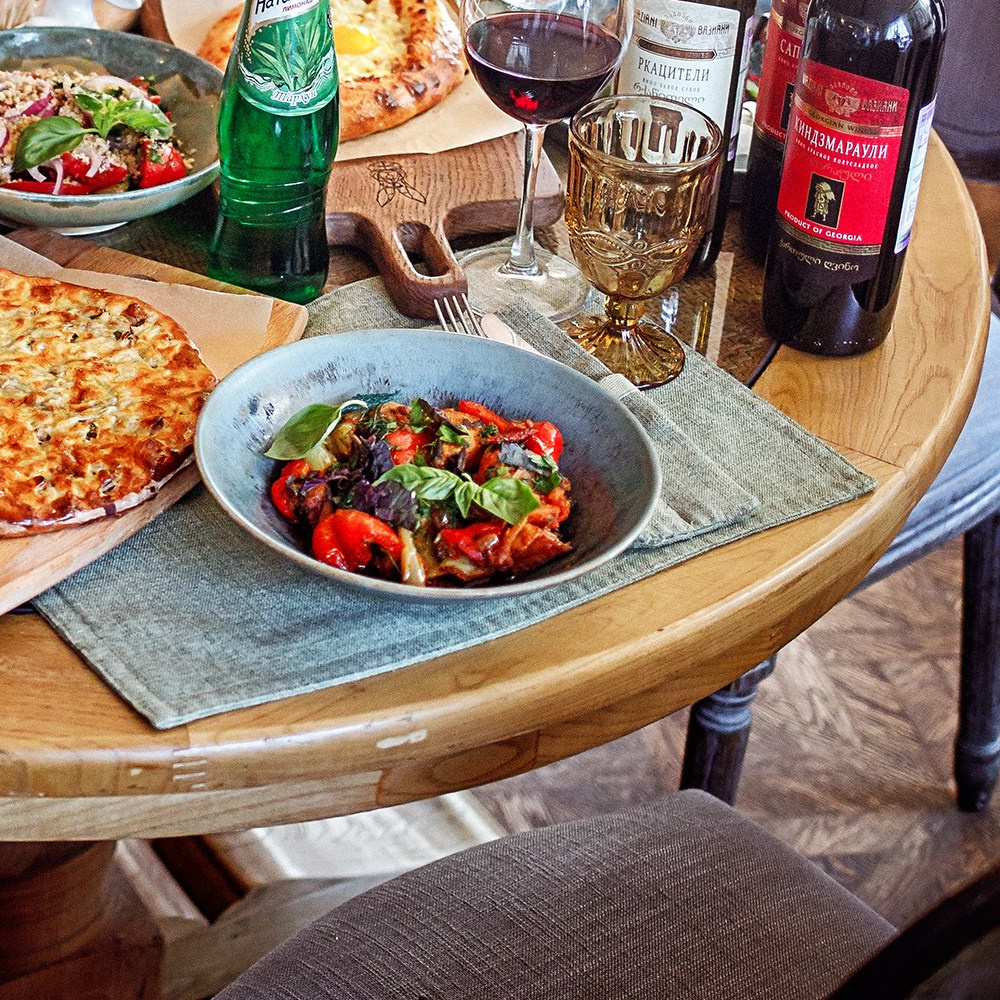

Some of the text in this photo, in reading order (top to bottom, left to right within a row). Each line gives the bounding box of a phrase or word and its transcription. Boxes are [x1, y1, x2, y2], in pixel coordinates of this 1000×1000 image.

[638, 56, 710, 82] РКАЦИТЕЛИ
[794, 116, 888, 159] КИНДЗМАРАУЛИ
[784, 209, 862, 242] PRODUCT OF GEORGIA
